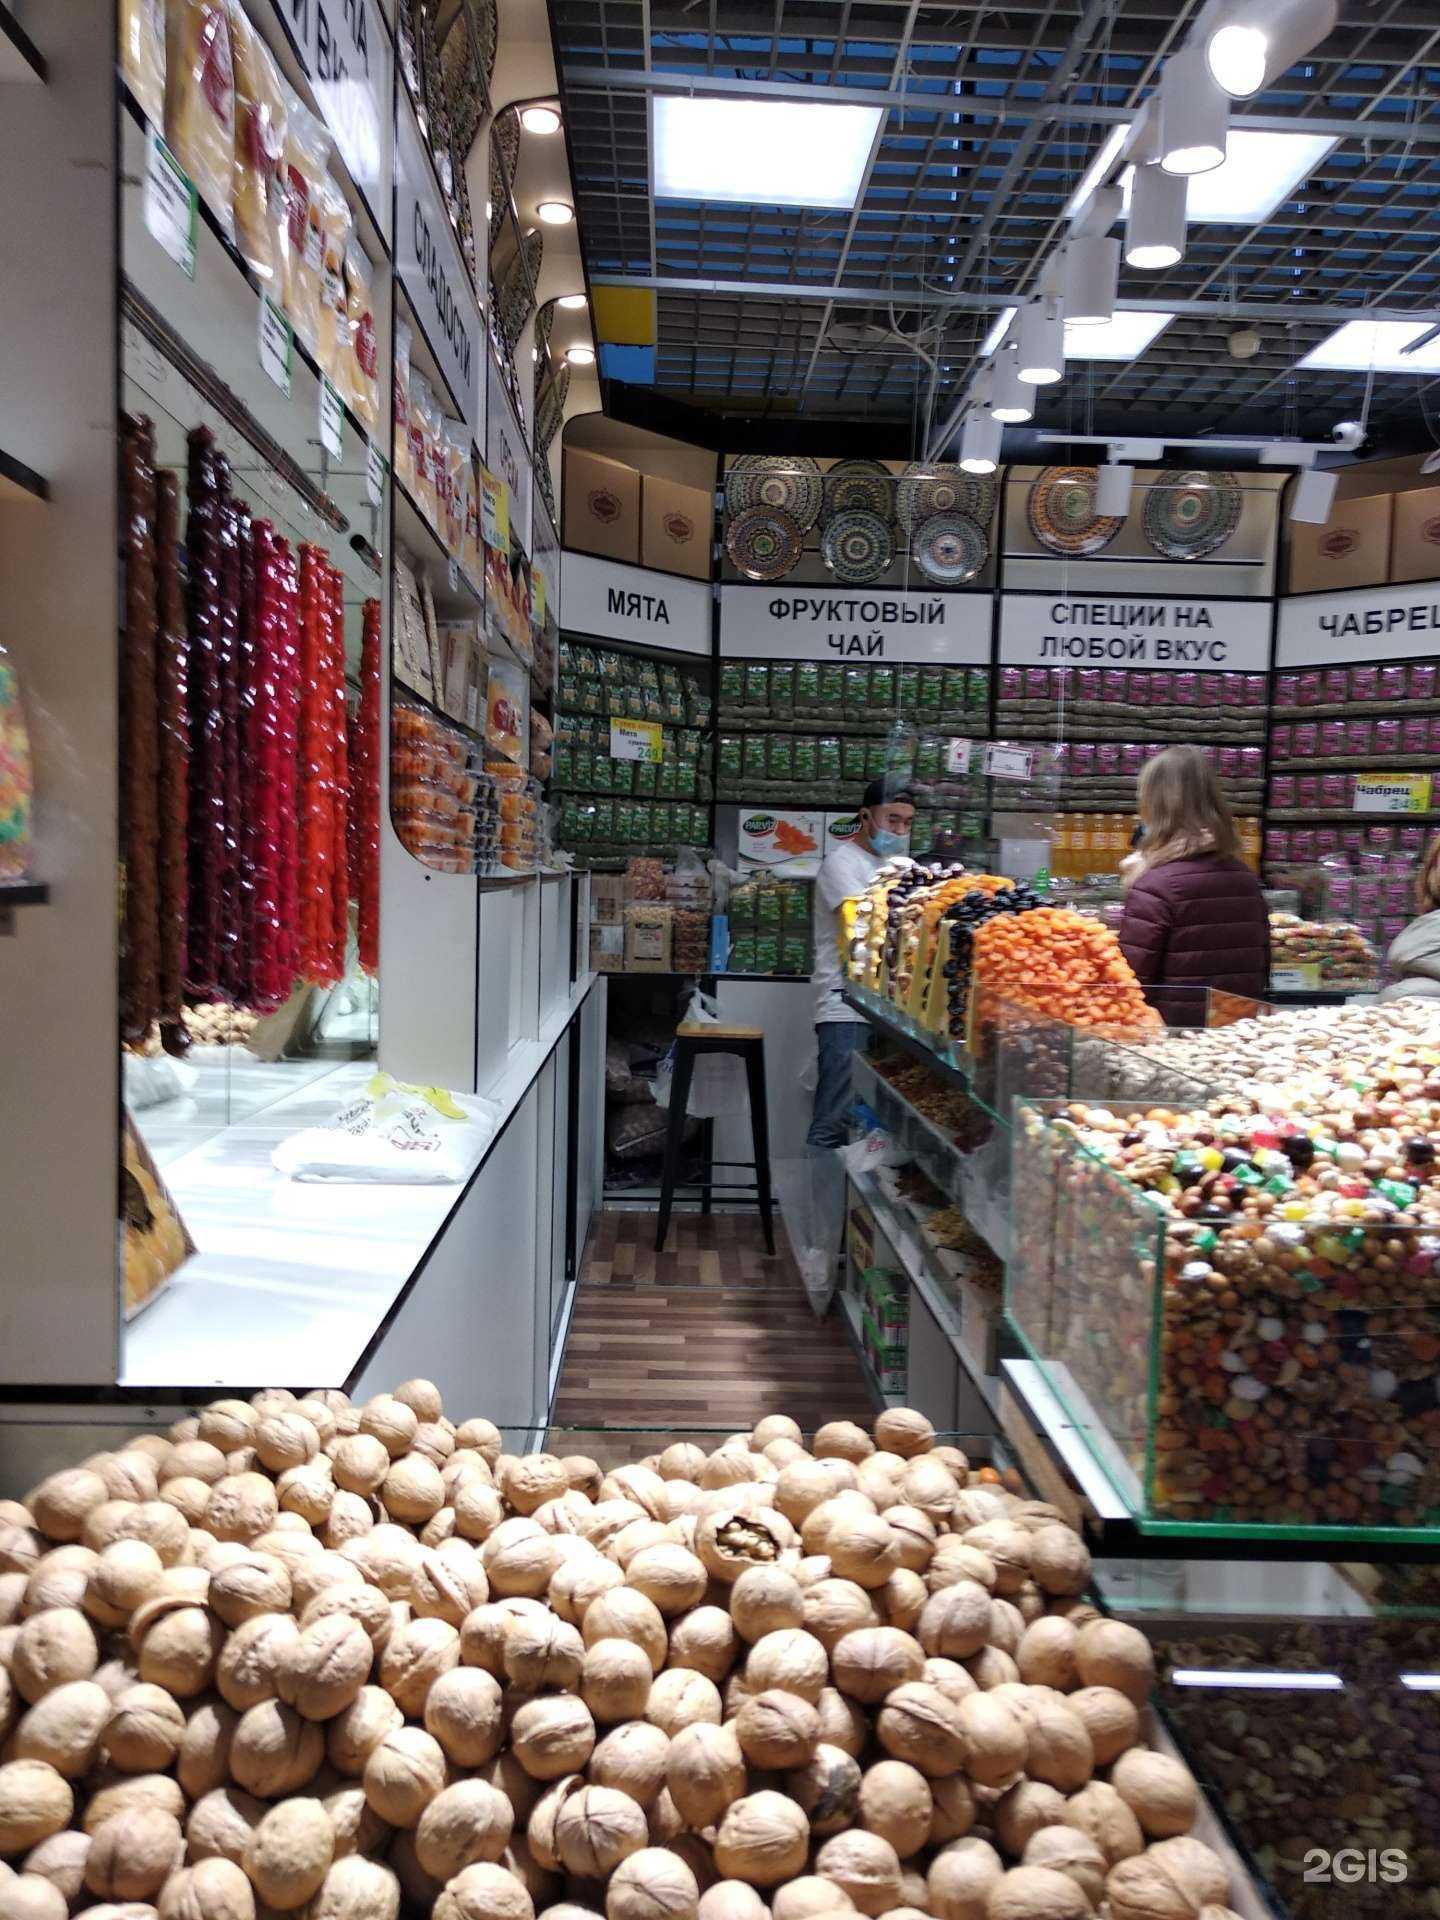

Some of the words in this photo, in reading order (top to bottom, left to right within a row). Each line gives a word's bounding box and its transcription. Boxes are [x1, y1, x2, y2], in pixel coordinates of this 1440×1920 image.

[413, 200, 471, 388] СЛАДОСТИ
[608, 587, 670, 625] МЯТА
[769, 598, 945, 625] ФРУКТОВЫЙ
[1051, 603, 1166, 630] СПЕЦИИ
[1174, 606, 1214, 628] НА
[828, 629, 884, 656] ЧАЙ
[1039, 633, 1145, 661] ЛЮБОЙ
[1156, 639, 1228, 662] ВКУС
[1356, 784, 1411, 797] Чабрец
